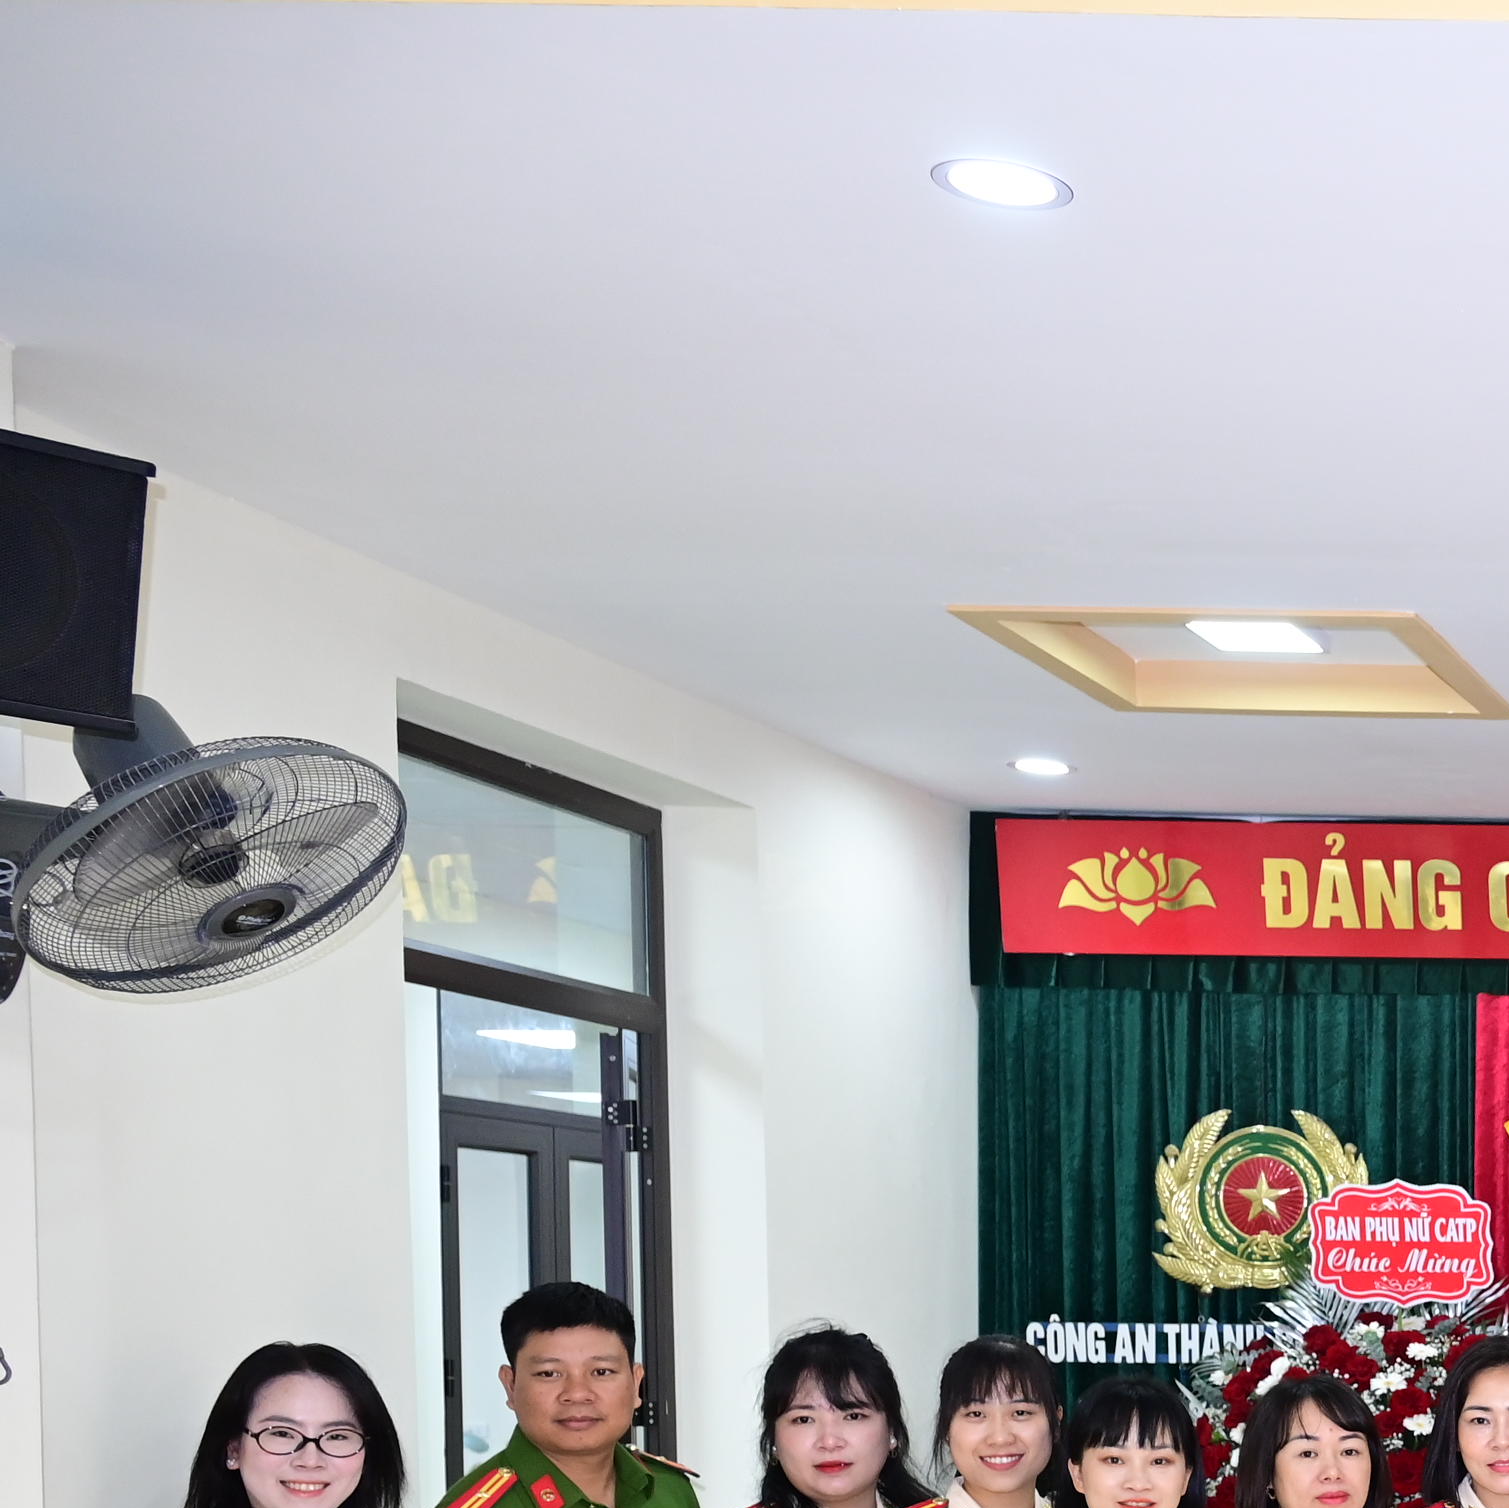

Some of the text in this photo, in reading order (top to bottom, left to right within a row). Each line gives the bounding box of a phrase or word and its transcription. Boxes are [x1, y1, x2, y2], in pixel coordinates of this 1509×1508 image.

[1260, 832, 1463, 932] ĐẢNG
[1325, 1211, 1477, 1248] BAN PHỤ NỮ CATP
[1327, 1247, 1478, 1279] Chúc Mừng
[1025, 1313, 1106, 1364] CÔNG
[1114, 1322, 1156, 1364] AN
